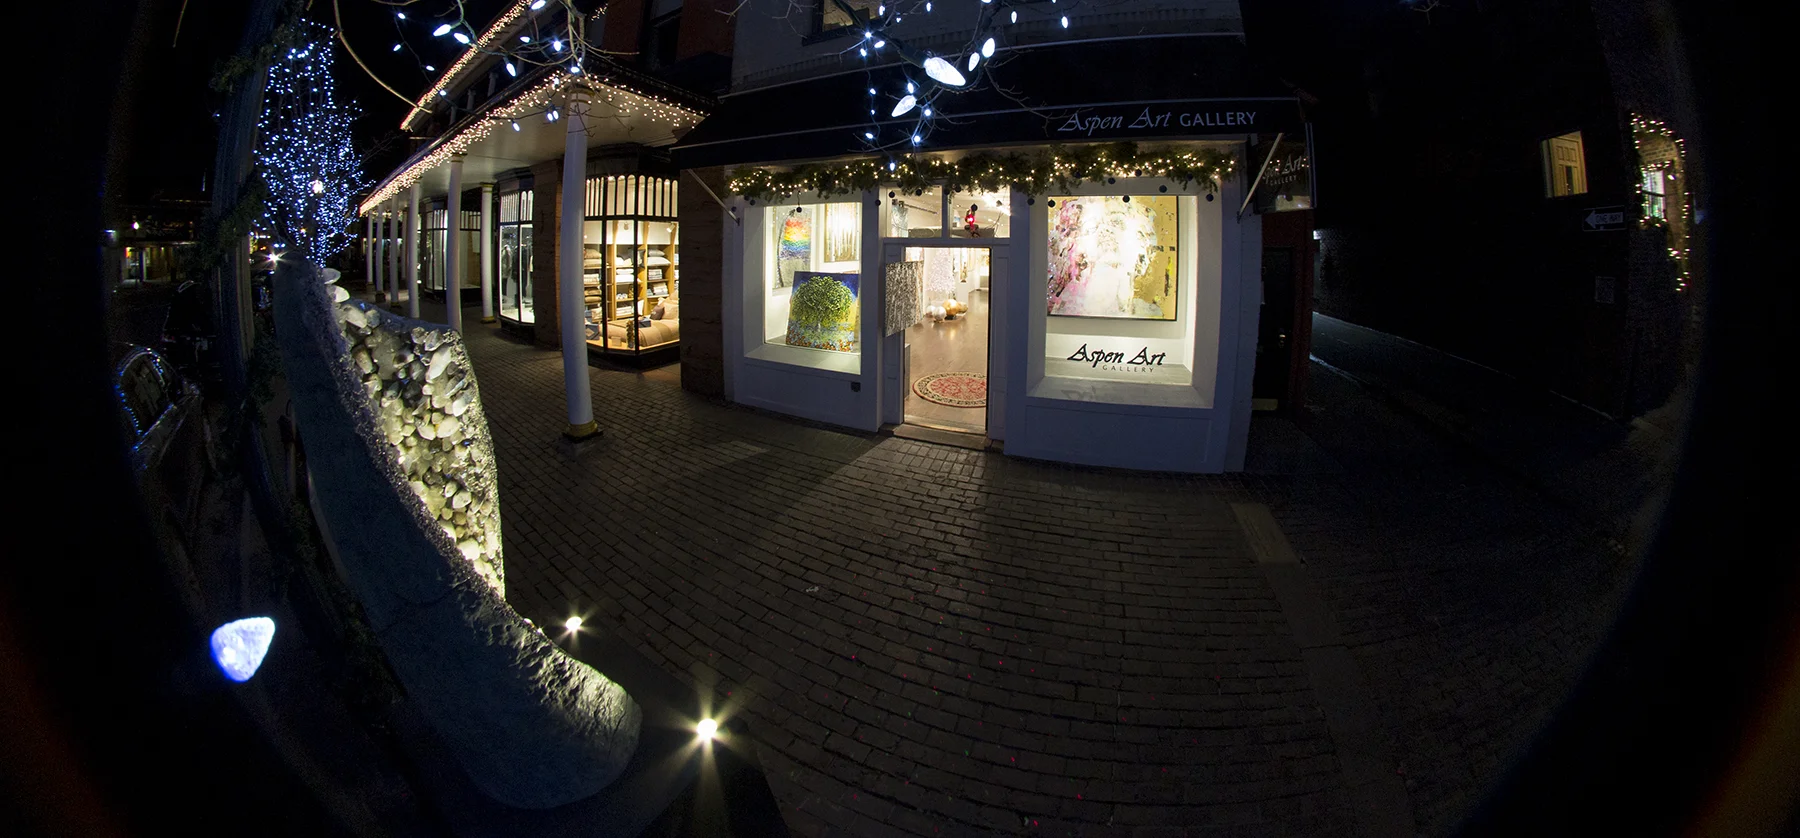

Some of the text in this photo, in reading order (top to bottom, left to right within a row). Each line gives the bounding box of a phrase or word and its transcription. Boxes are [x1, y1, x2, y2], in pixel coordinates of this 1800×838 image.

[1057, 106, 1257, 137] Aspen Art GALLERY
[1066, 343, 1166, 368] Aspen Art
[1102, 365, 1154, 373] GALLERY
